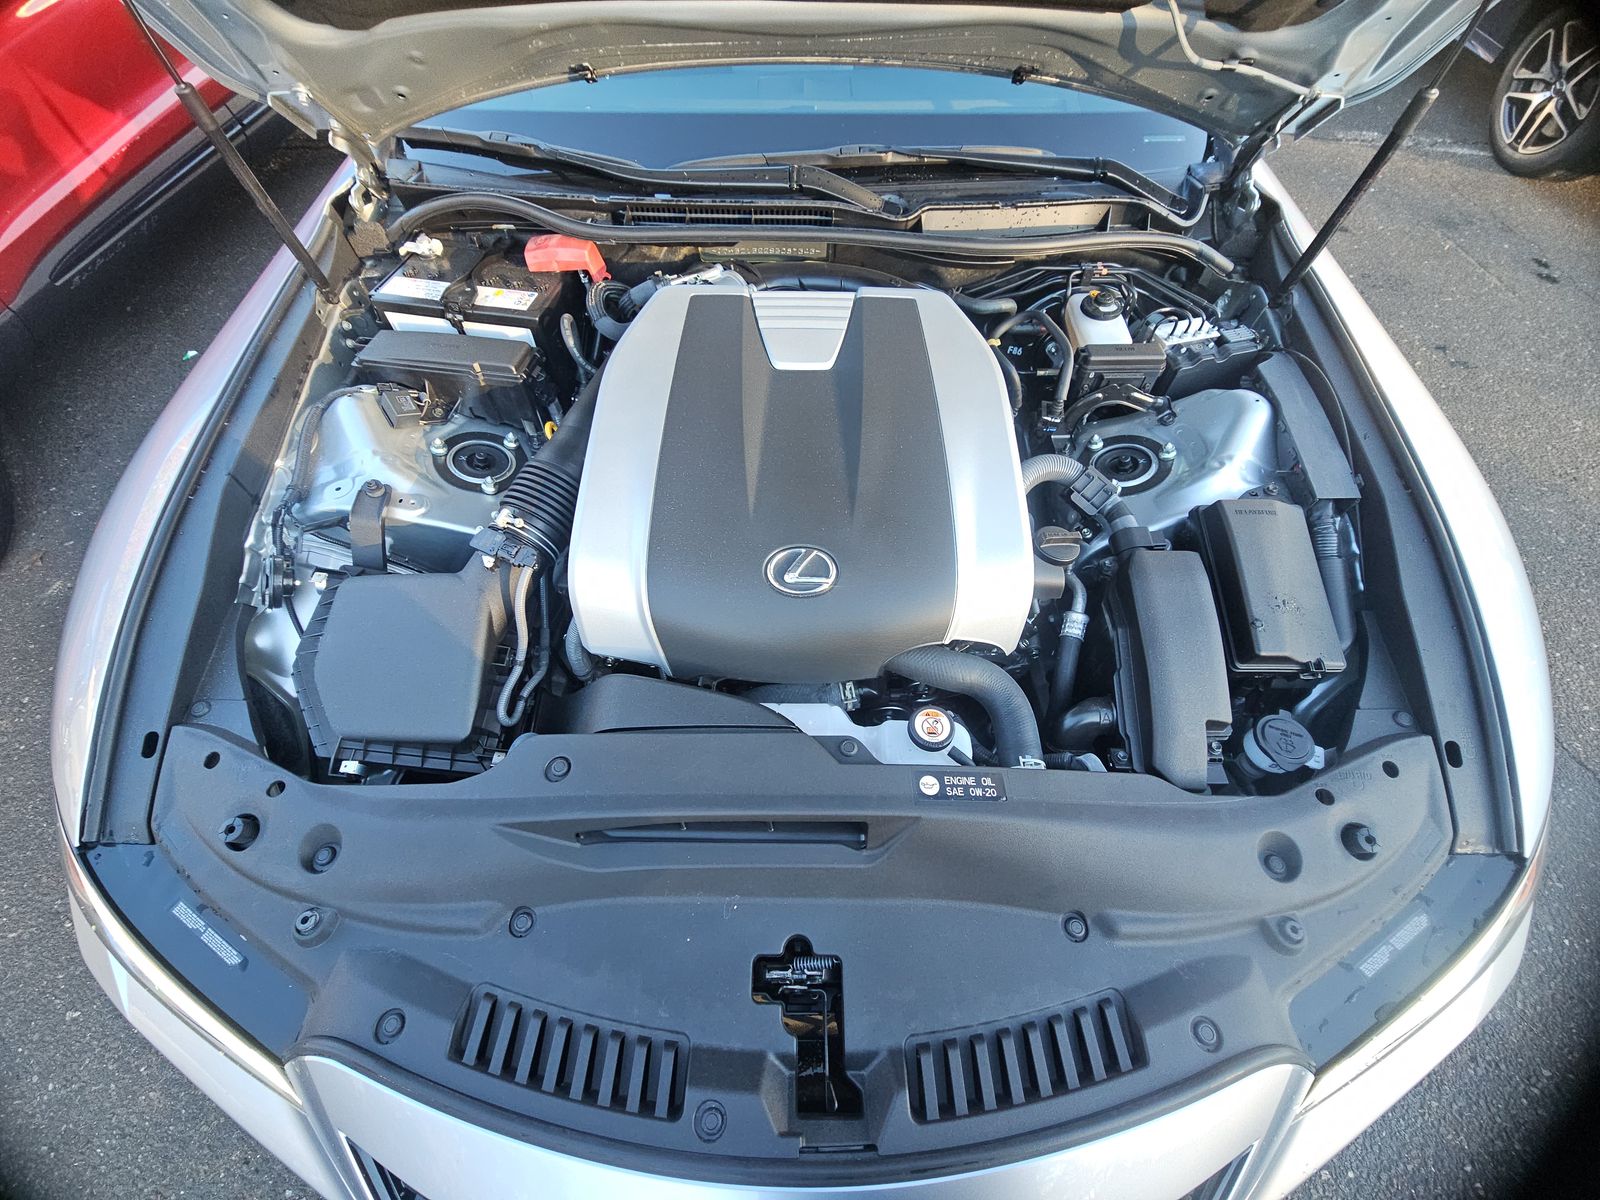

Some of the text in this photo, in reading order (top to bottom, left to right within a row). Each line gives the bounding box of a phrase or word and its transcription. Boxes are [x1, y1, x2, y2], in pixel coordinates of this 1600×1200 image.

[1007, 345, 1023, 356] F86
[944, 776, 996, 786] ENGINE OIL
[946, 787, 997, 797] SAE 0W-20
